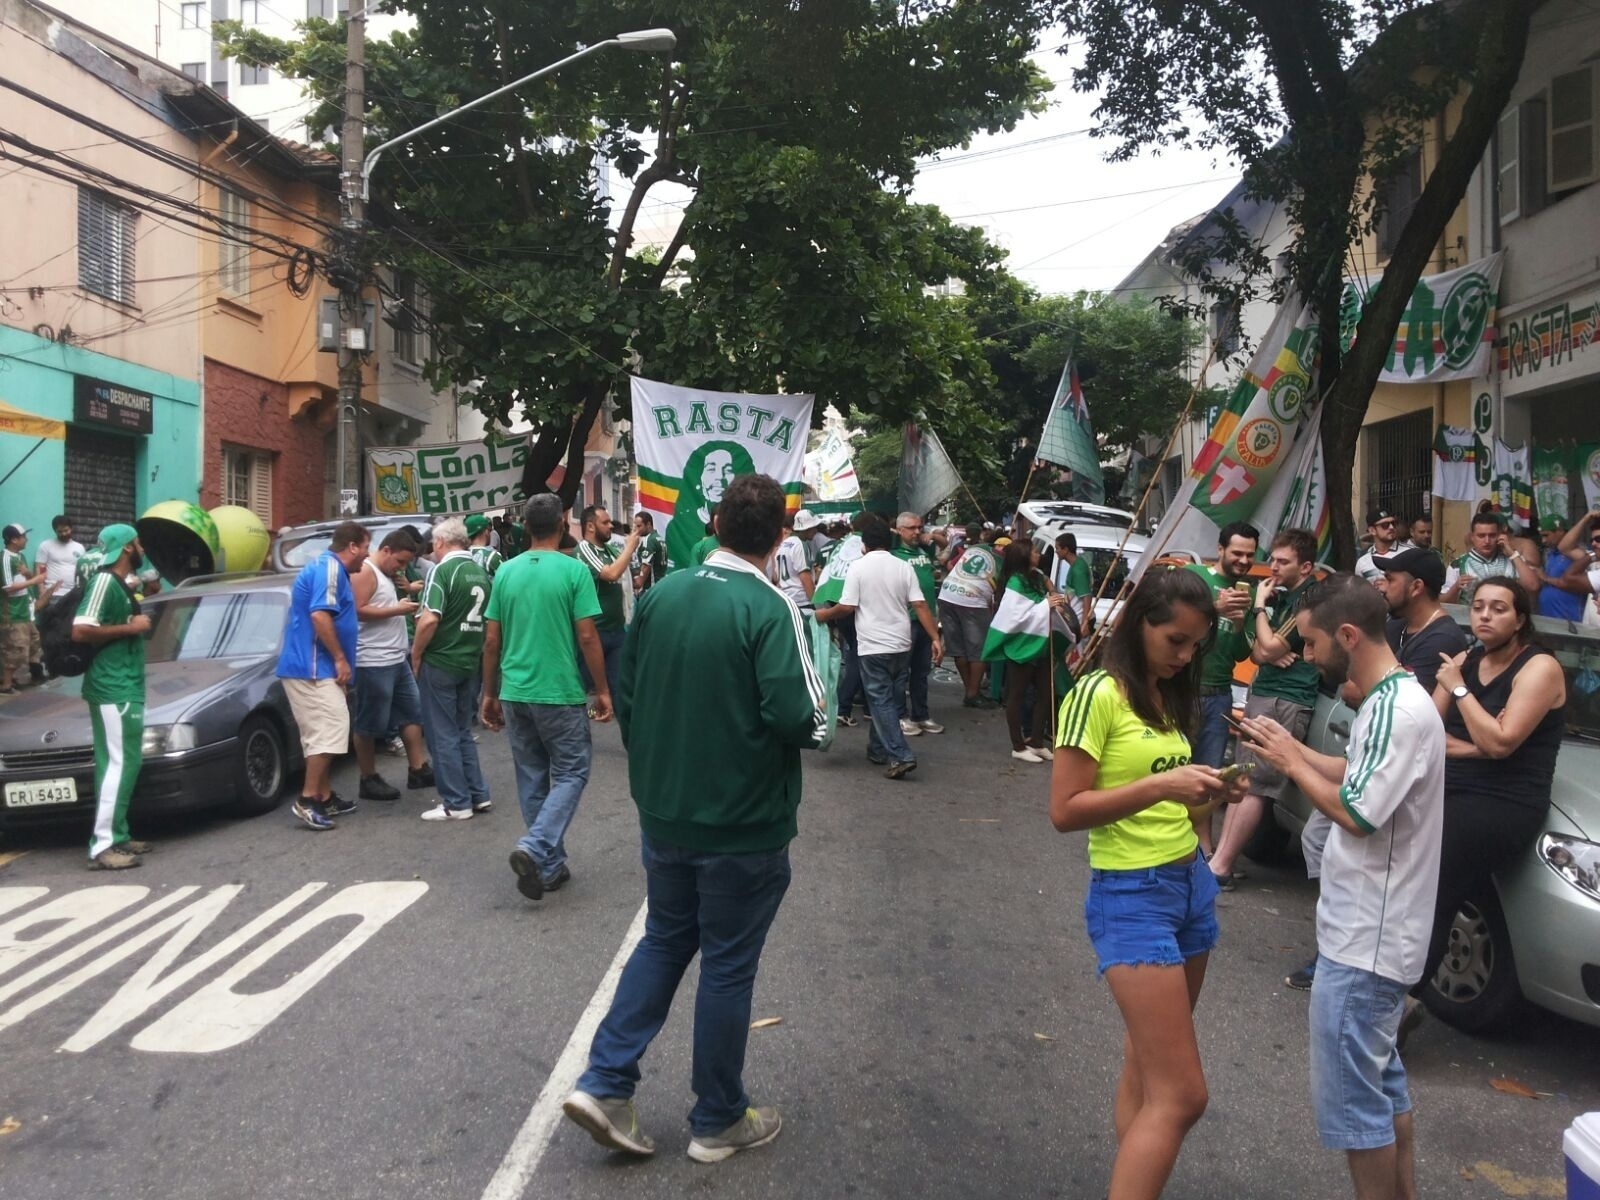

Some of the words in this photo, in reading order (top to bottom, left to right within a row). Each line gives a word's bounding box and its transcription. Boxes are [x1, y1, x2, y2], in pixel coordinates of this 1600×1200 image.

[1509, 303, 1573, 379] RASTA
[652, 401, 796, 453] RASTA
[421, 480, 526, 513] Birra
[468, 585, 485, 622] 2
[38, 786, 71, 802] 5433
